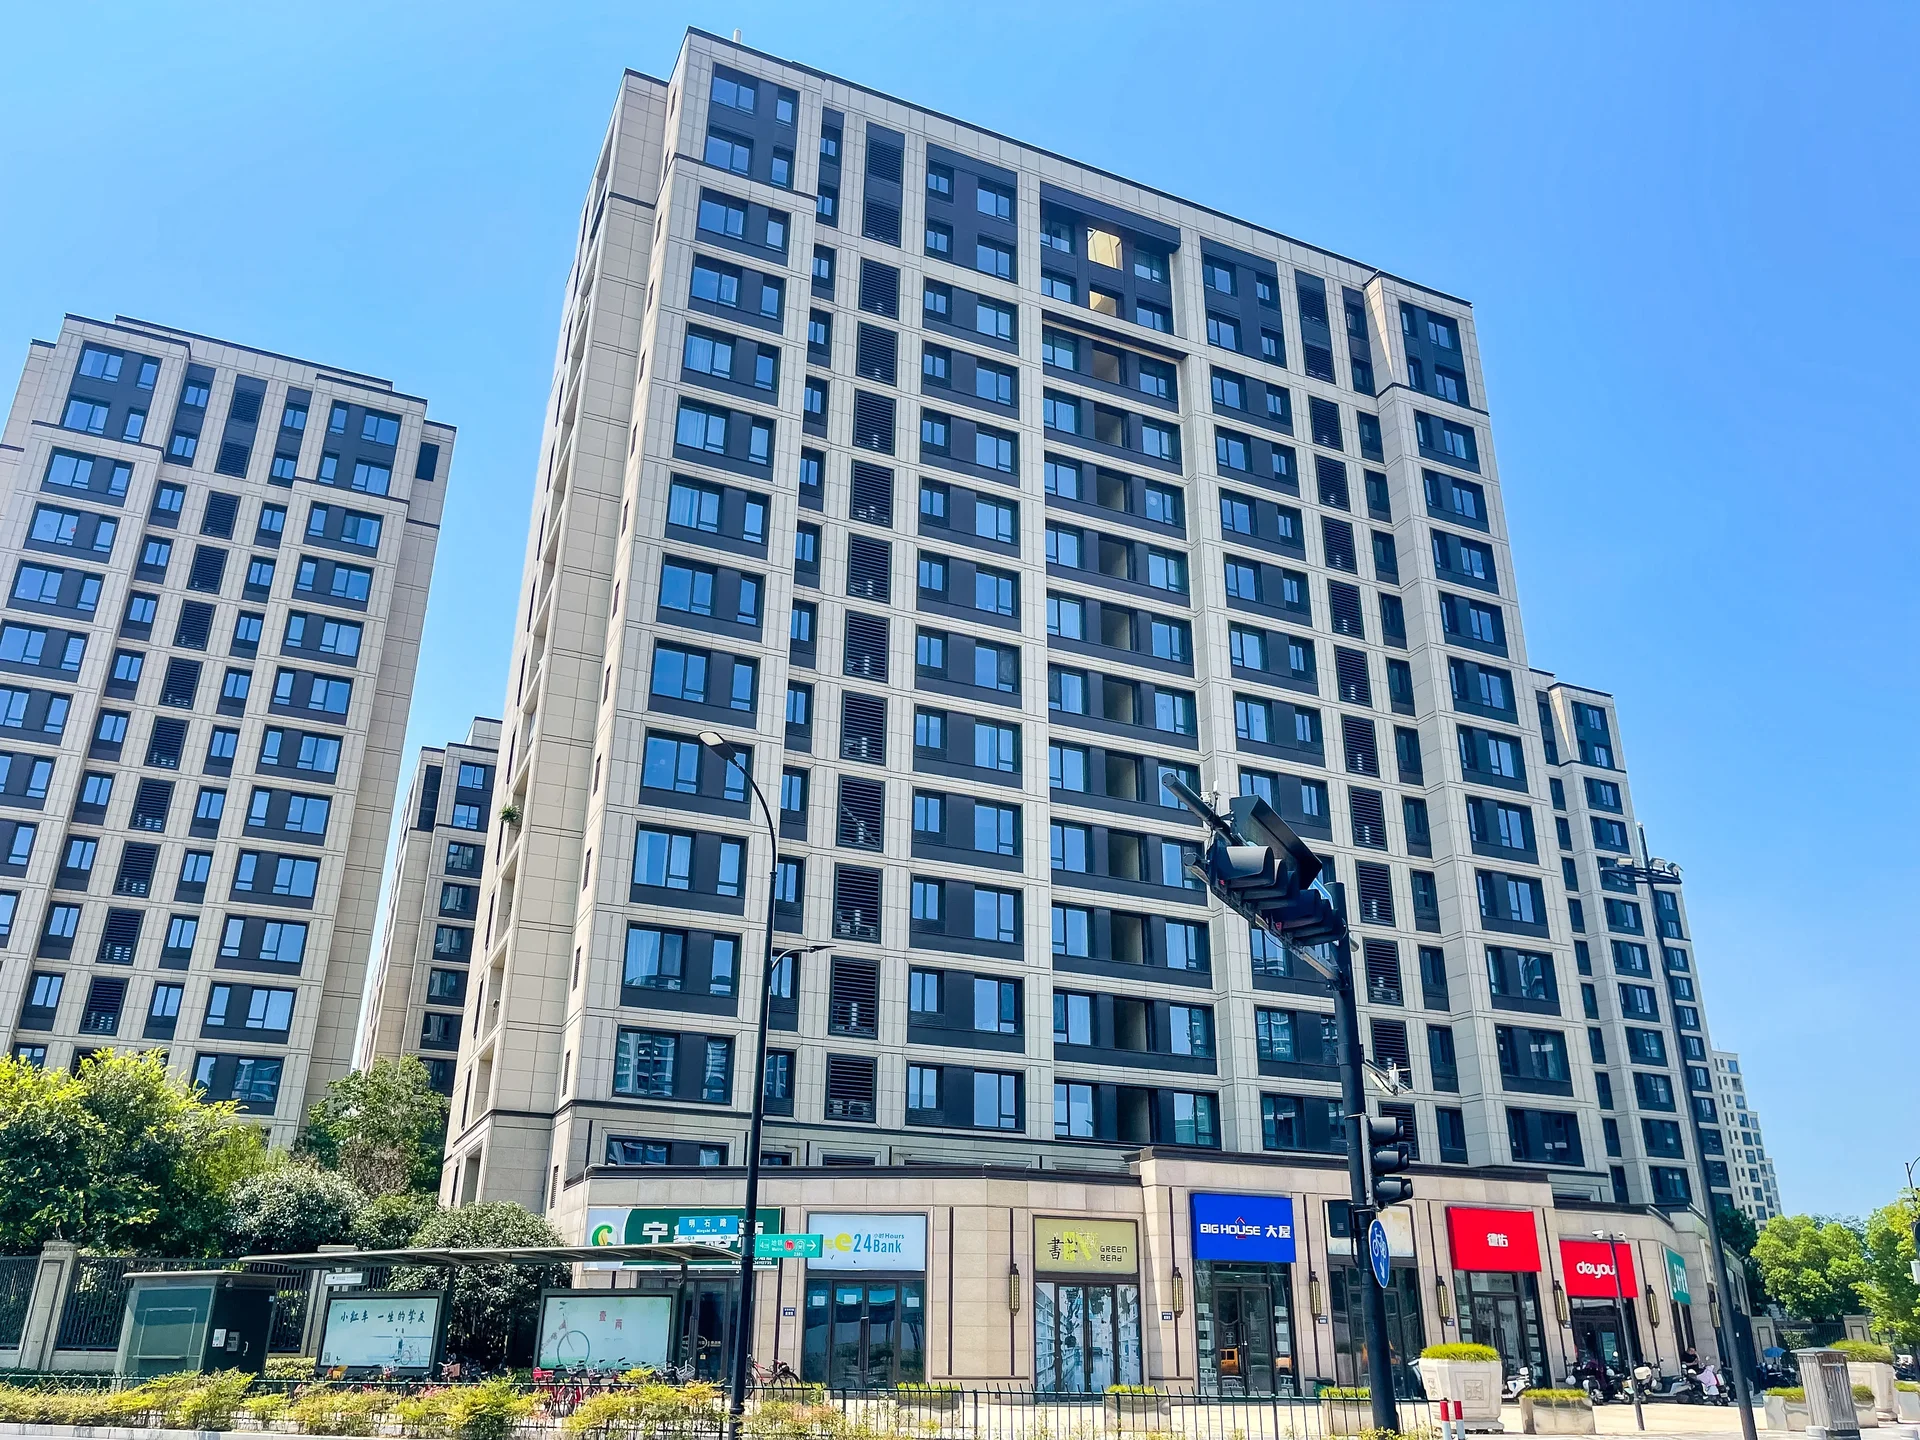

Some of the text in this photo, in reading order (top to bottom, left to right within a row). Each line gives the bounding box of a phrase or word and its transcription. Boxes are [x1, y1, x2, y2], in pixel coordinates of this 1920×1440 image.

[1200, 1223, 1291, 1239] BIG HOUSE 大屋
[853, 1233, 872, 1253] 24
[873, 1239, 902, 1253] Bank
[1486, 1232, 1509, 1247] 德佑
[1575, 1260, 1616, 1279] deyou
